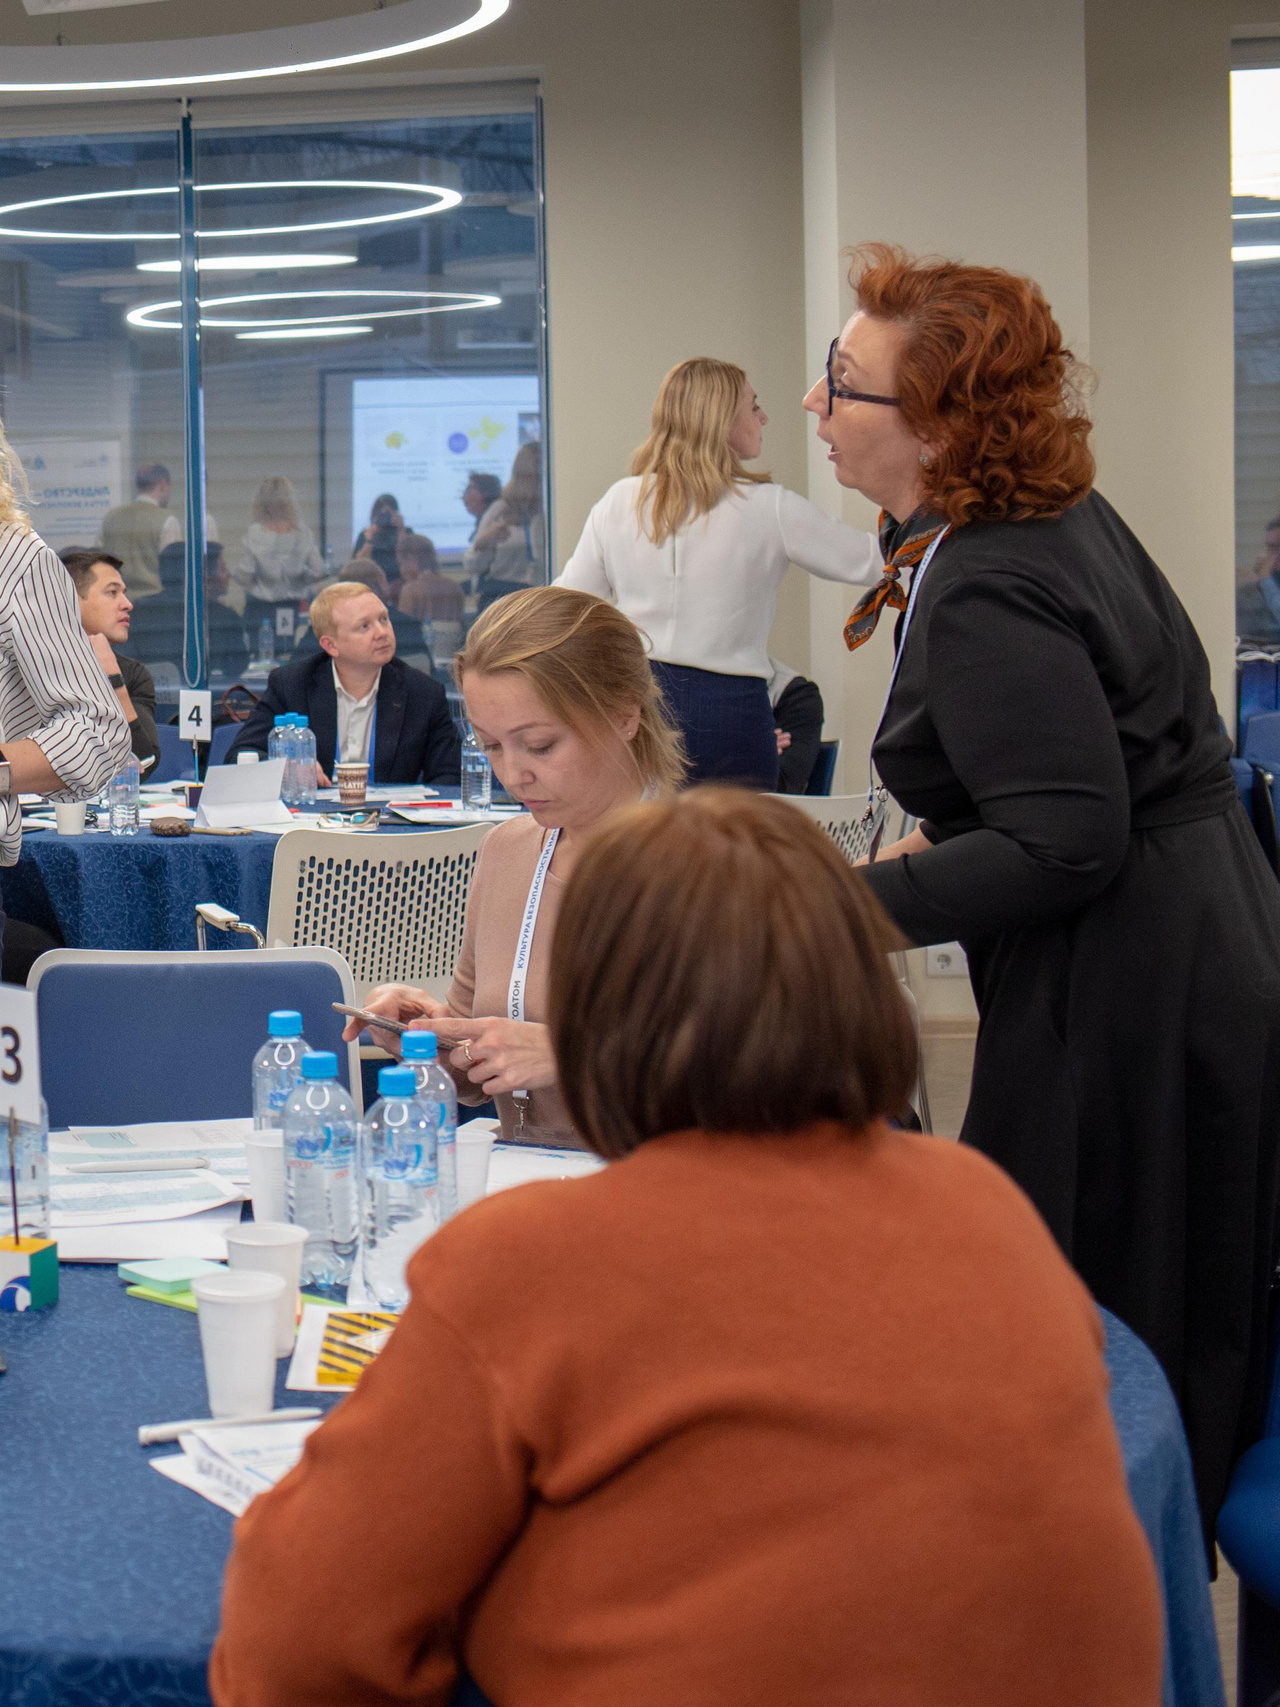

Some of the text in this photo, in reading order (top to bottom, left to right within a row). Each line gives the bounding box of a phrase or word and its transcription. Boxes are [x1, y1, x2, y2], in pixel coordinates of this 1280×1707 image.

[188, 706, 202, 727] 4
[512, 980, 521, 1020] ОАТОМ
[517, 922, 531, 969] КУЛЬТУРА
[527, 848, 551, 920] БЕЗОПАСНОСТИ
[0, 1026, 23, 1084] 3
